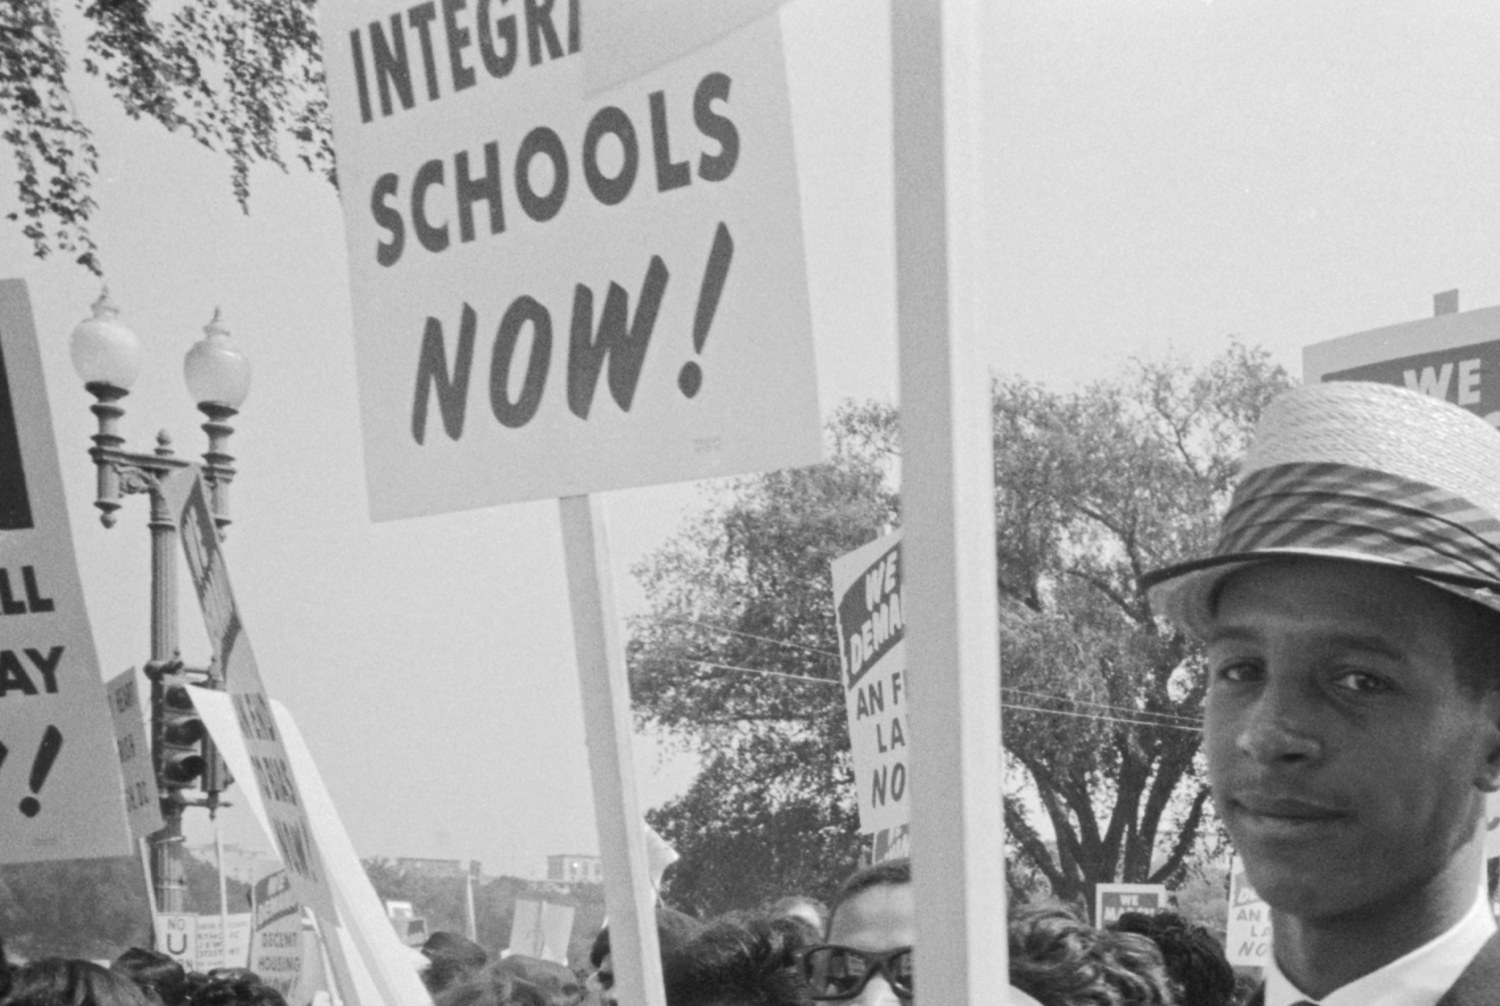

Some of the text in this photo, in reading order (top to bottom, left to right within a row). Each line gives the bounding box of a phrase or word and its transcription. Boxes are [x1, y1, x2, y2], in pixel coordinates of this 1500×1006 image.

[350, 0, 581, 123] INTEGR
[370, 72, 740, 268] SCHOOLS
[411, 221, 734, 446] NOW!
[1403, 358, 1482, 405] WE
[0, 565, 55, 616] LL
[865, 550, 898, 612] WE
[850, 593, 903, 675] DEMA
[0, 645, 65, 697] AY
[856, 680, 884, 721] AN
[876, 717, 906, 753] LA
[872, 762, 906, 808] NO
[1120, 895, 1139, 906] WE
[1236, 908, 1261, 922] AN
[166, 933, 187, 955] U
[167, 918, 186, 931] NO
[261, 932, 297, 948] DECENT
[1237, 940, 1267, 957] NO
